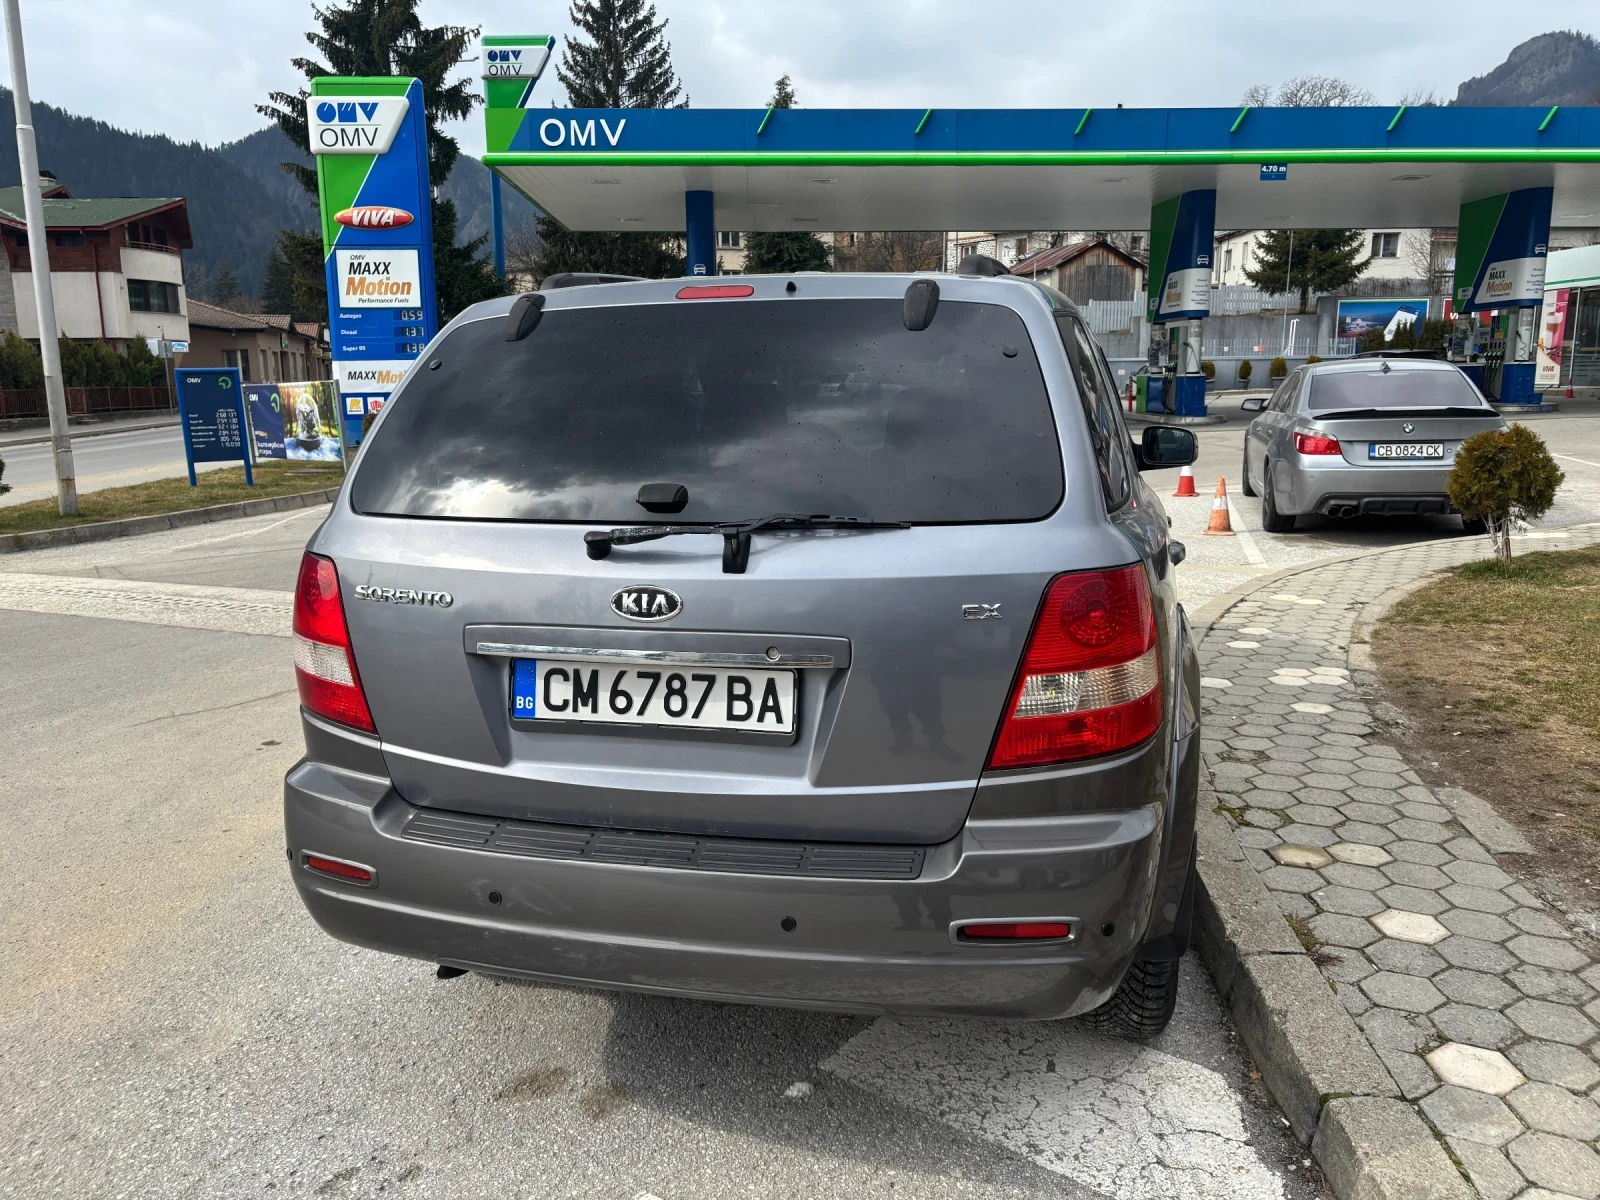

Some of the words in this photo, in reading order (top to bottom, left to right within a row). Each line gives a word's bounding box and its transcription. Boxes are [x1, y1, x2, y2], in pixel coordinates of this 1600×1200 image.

[488, 65, 522, 76] OMV
[320, 128, 378, 147] OMV
[540, 118, 626, 146] OMV
[351, 209, 395, 227] VIVA
[348, 262, 391, 275] MAXX
[1489, 270, 1506, 280] MAXX
[346, 277, 411, 296] Motion
[1486, 280, 1512, 293] Motion
[402, 311, 423, 320] 0.59
[406, 327, 424, 336] 1.37
[1378, 446, 1392, 456] CB
[1396, 446, 1423, 456] 0824
[1426, 445, 1440, 456] CK
[355, 584, 453, 608] SORENTO
[622, 592, 670, 614] KIA
[962, 603, 1002, 620] EX
[516, 696, 533, 710] BG
[544, 668, 599, 714] CM
[609, 670, 716, 719] 6787
[727, 675, 783, 724] BA
